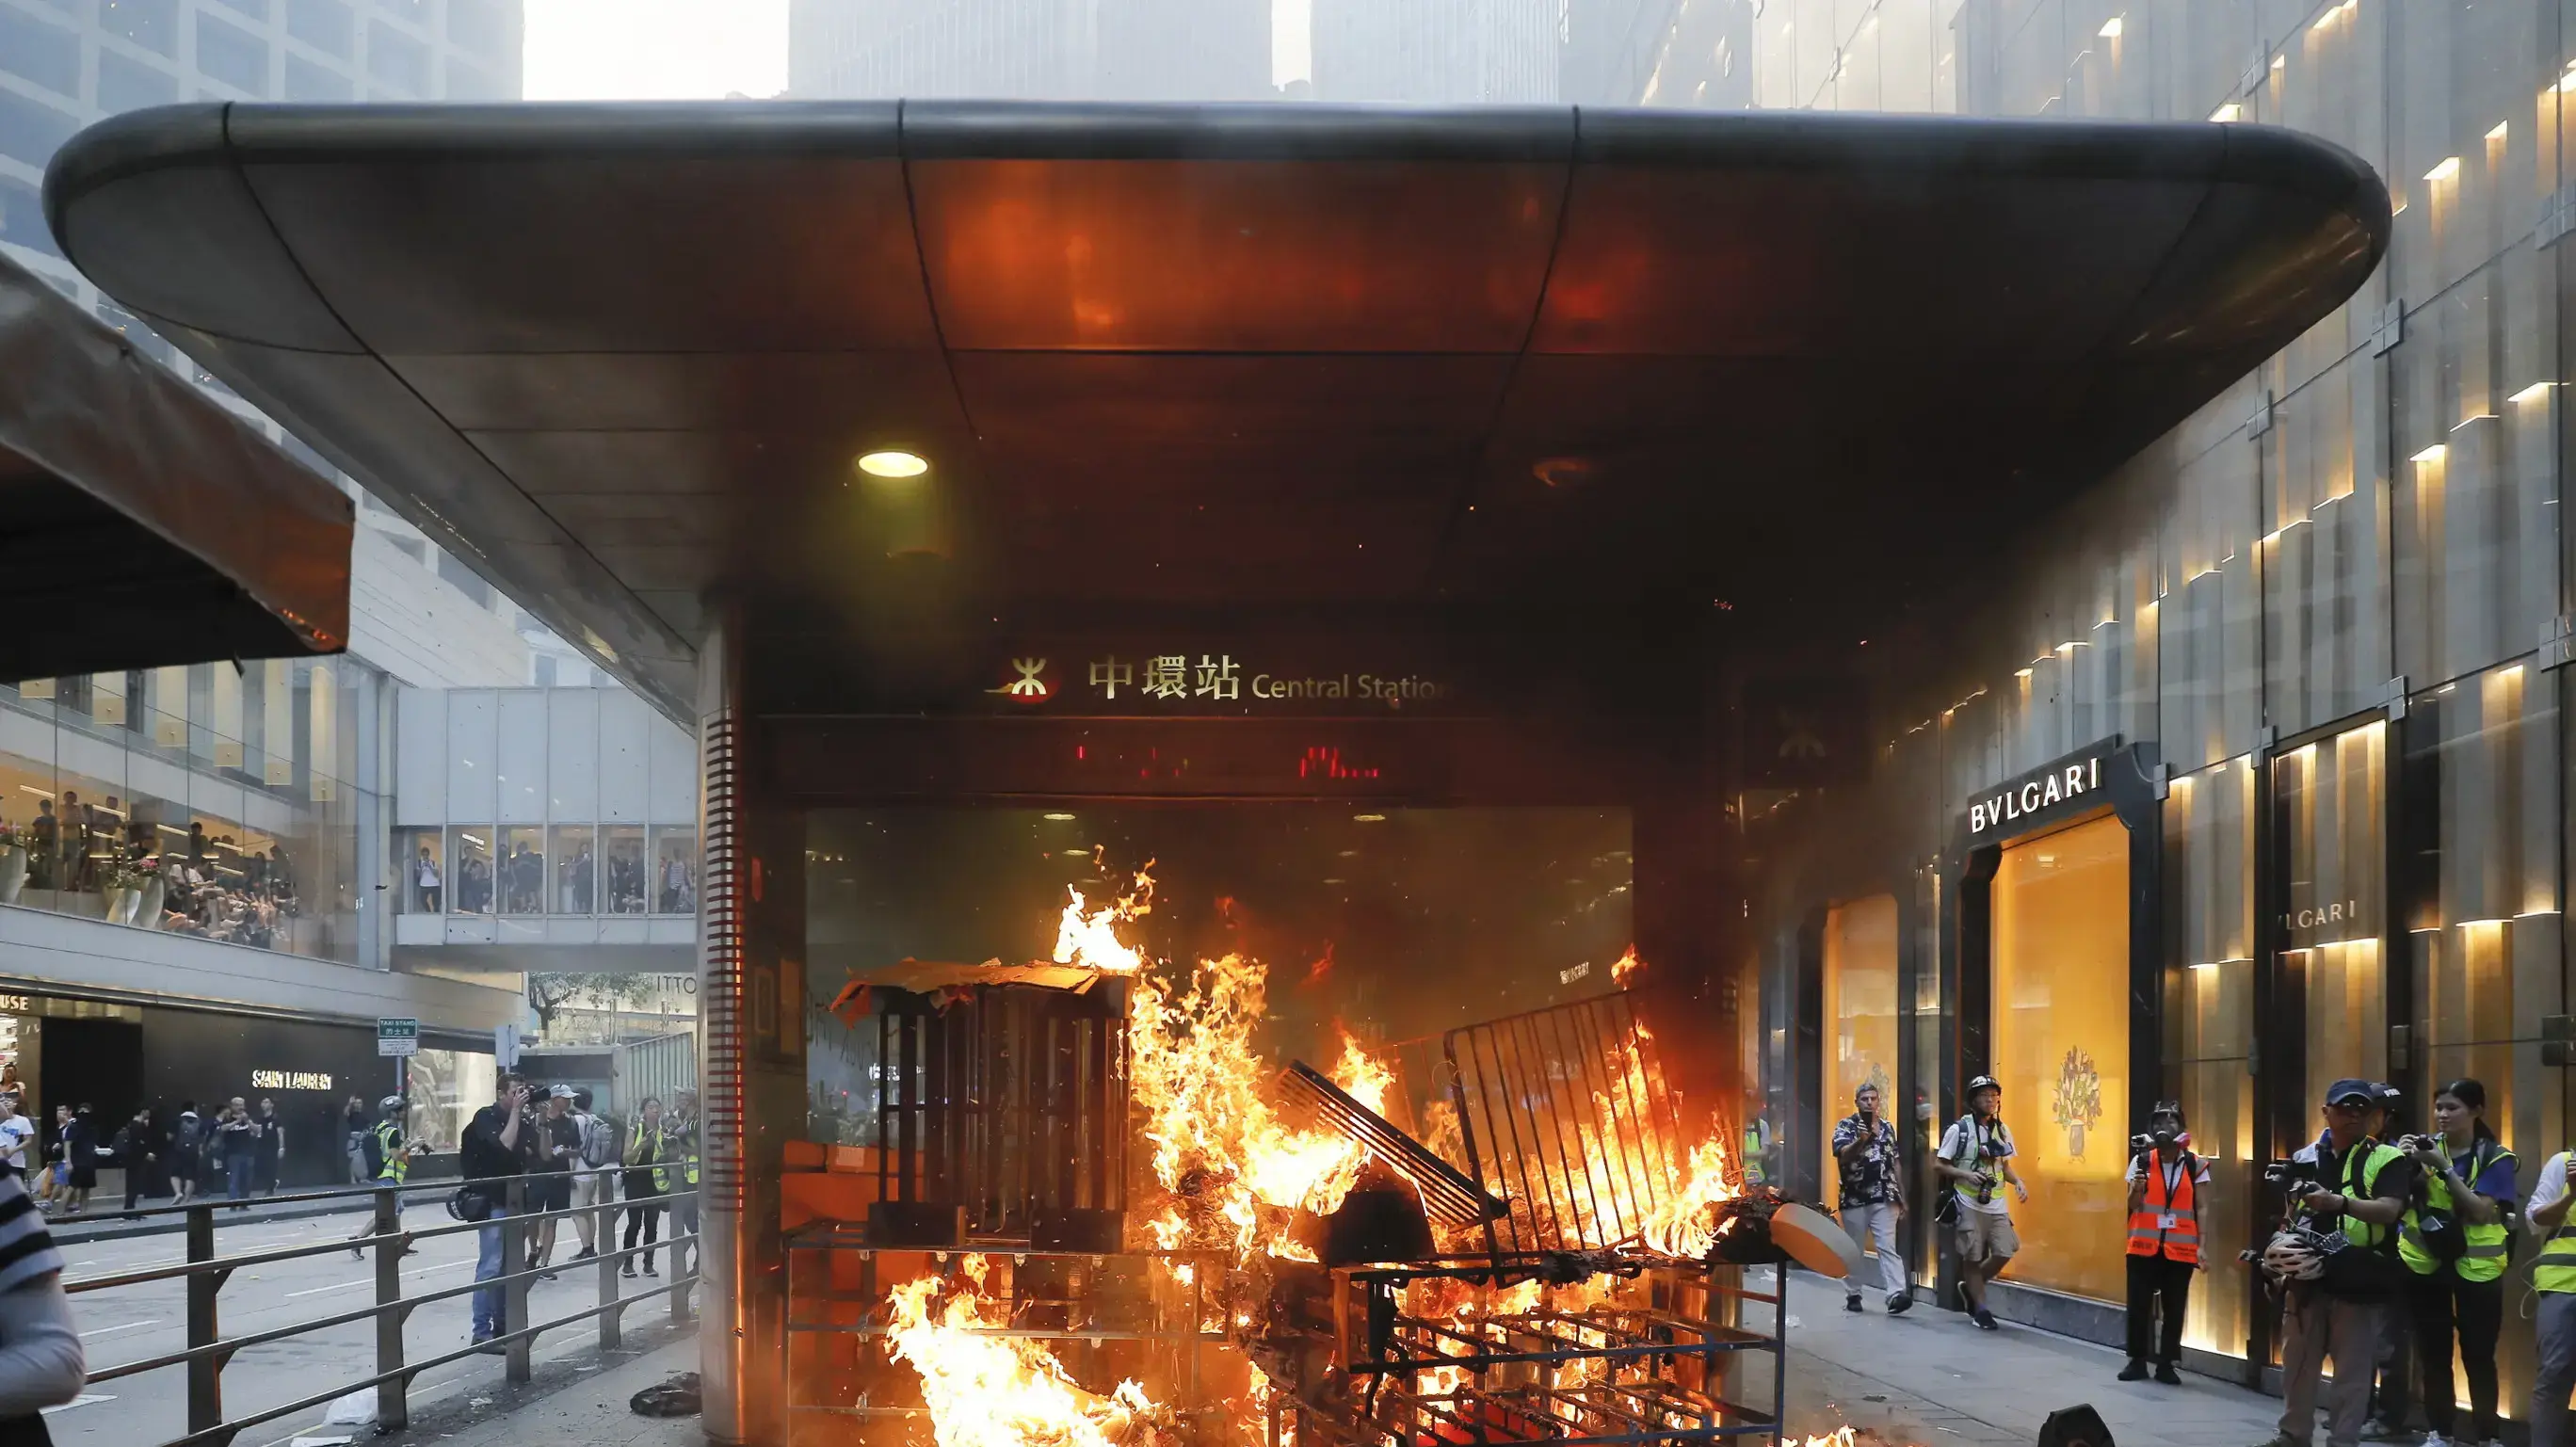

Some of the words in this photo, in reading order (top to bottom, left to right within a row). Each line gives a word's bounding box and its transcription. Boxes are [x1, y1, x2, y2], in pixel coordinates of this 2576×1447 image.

[1089, 655, 1241, 699] 中環站
[1251, 674, 1349, 699] Central
[1358, 675, 1450, 699] Statio
[1970, 758, 2098, 833] BVLGARI
